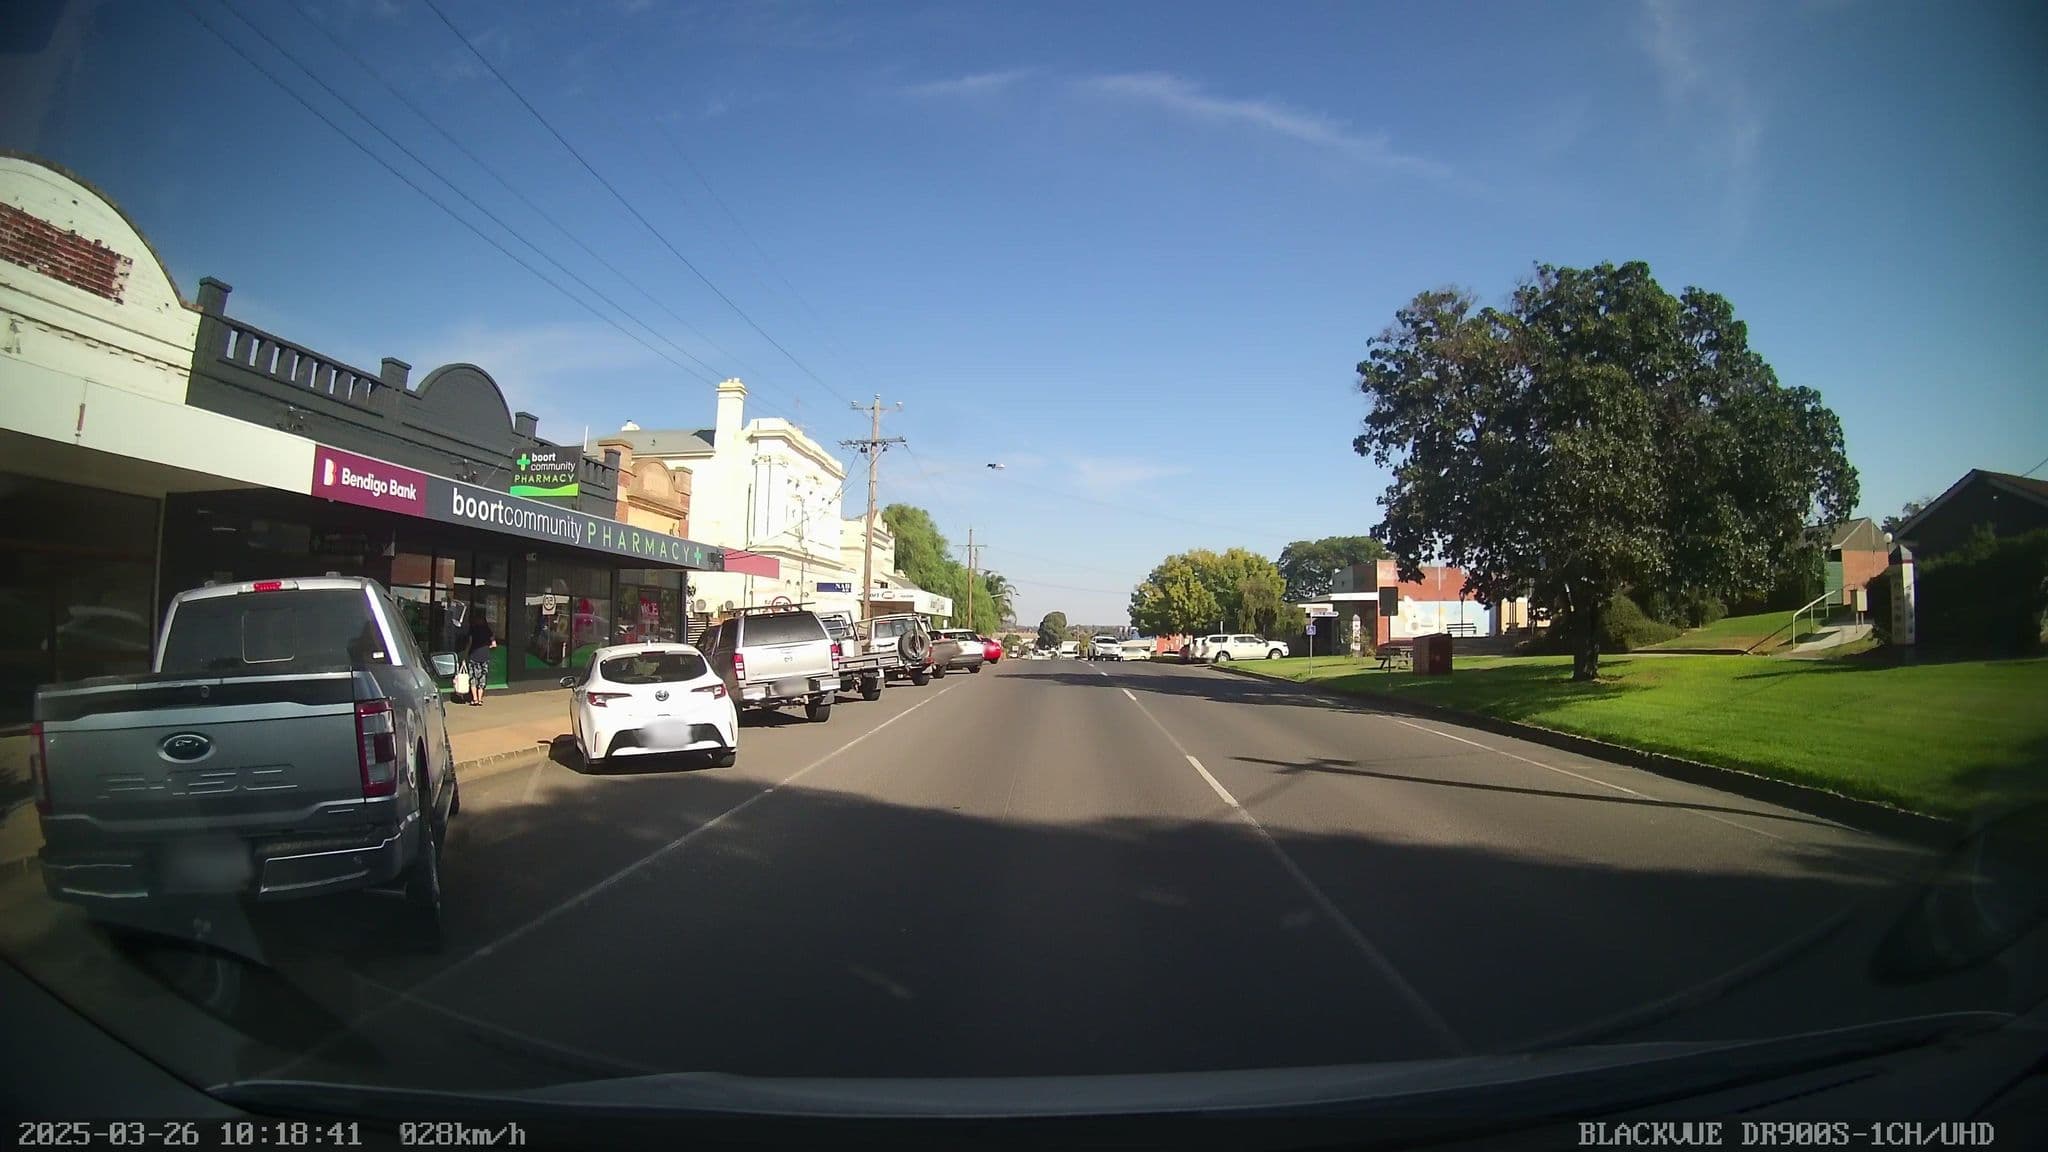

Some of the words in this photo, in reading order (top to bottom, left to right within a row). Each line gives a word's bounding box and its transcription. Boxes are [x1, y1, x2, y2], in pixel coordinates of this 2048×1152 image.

[531, 452, 556, 462] boort
[530, 461, 576, 472] community
[341, 467, 388, 497] Bendigo
[389, 479, 417, 501] Bank
[514, 473, 575, 484] PHARMACY
[587, 521, 690, 563] PHARMACY
